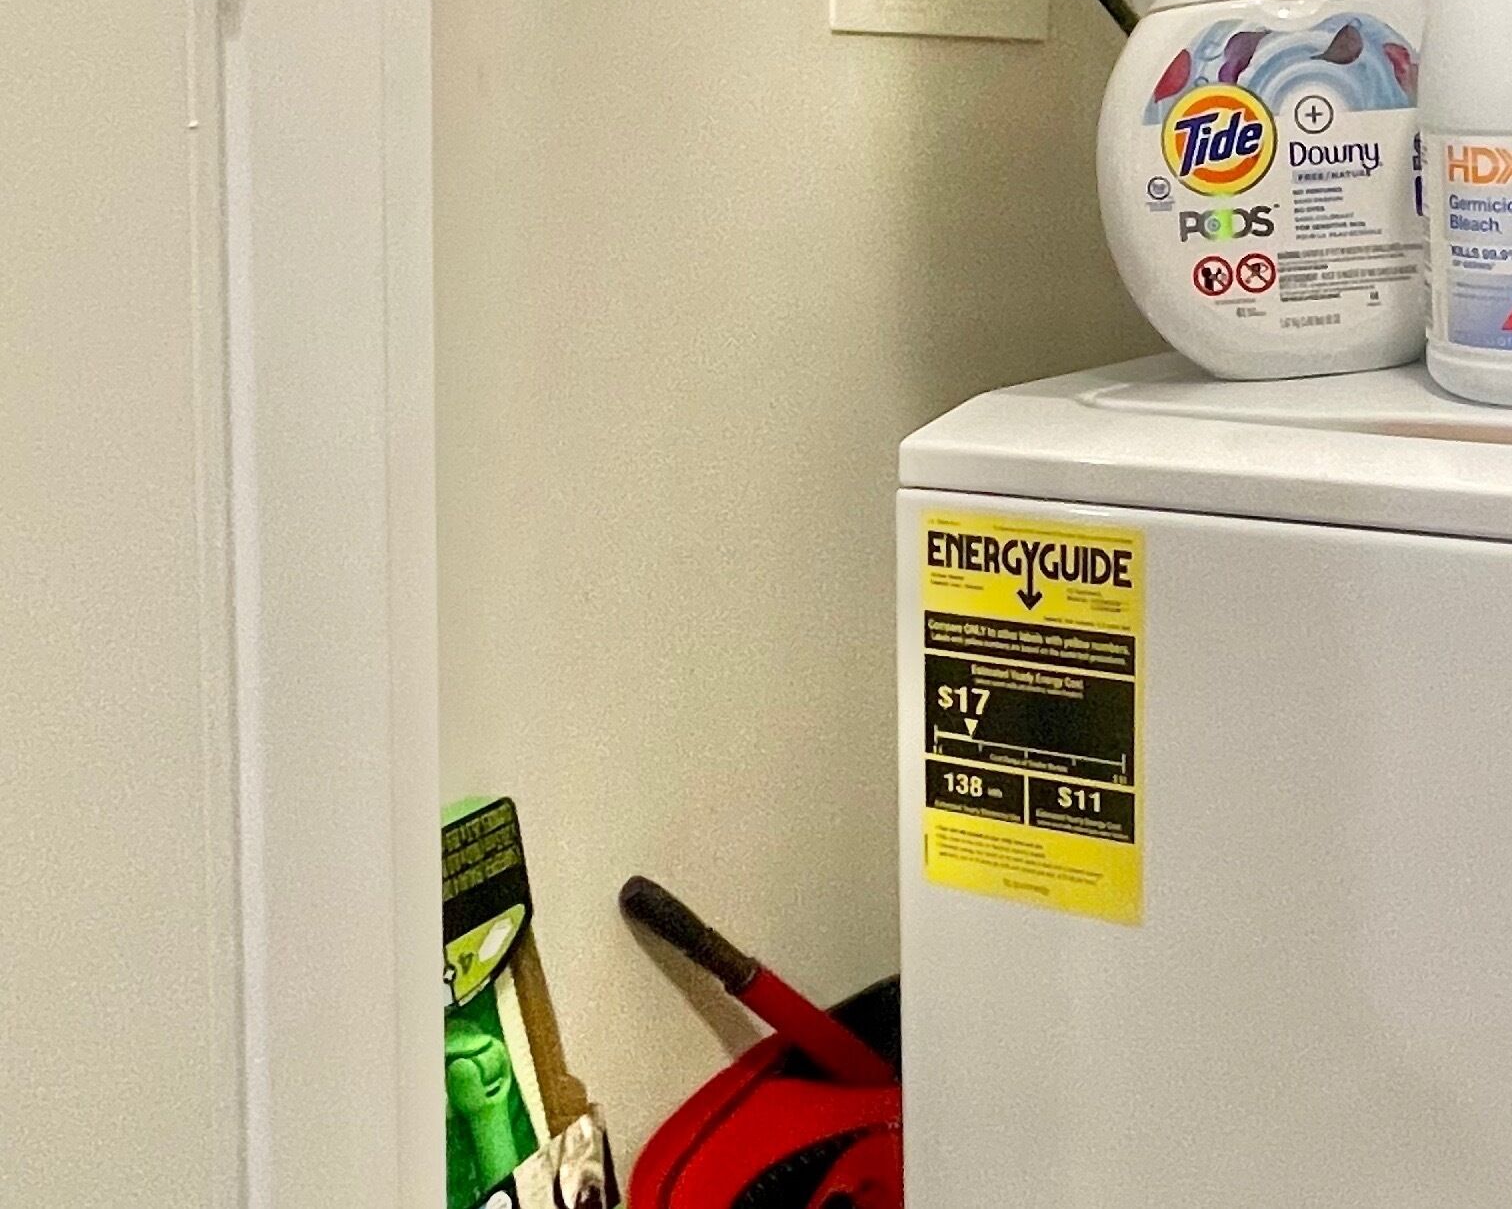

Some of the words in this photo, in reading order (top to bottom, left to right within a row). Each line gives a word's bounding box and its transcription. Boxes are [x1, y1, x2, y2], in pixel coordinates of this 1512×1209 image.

[1174, 111, 1264, 178] Tide
[1289, 139, 1381, 171] Downy
[1450, 214, 1500, 233] Bleach
[1451, 245, 1480, 259] KILLS
[928, 530, 1133, 589] ENERGYGUIDE
[937, 684, 990, 715] $17
[943, 772, 983, 798] 138
